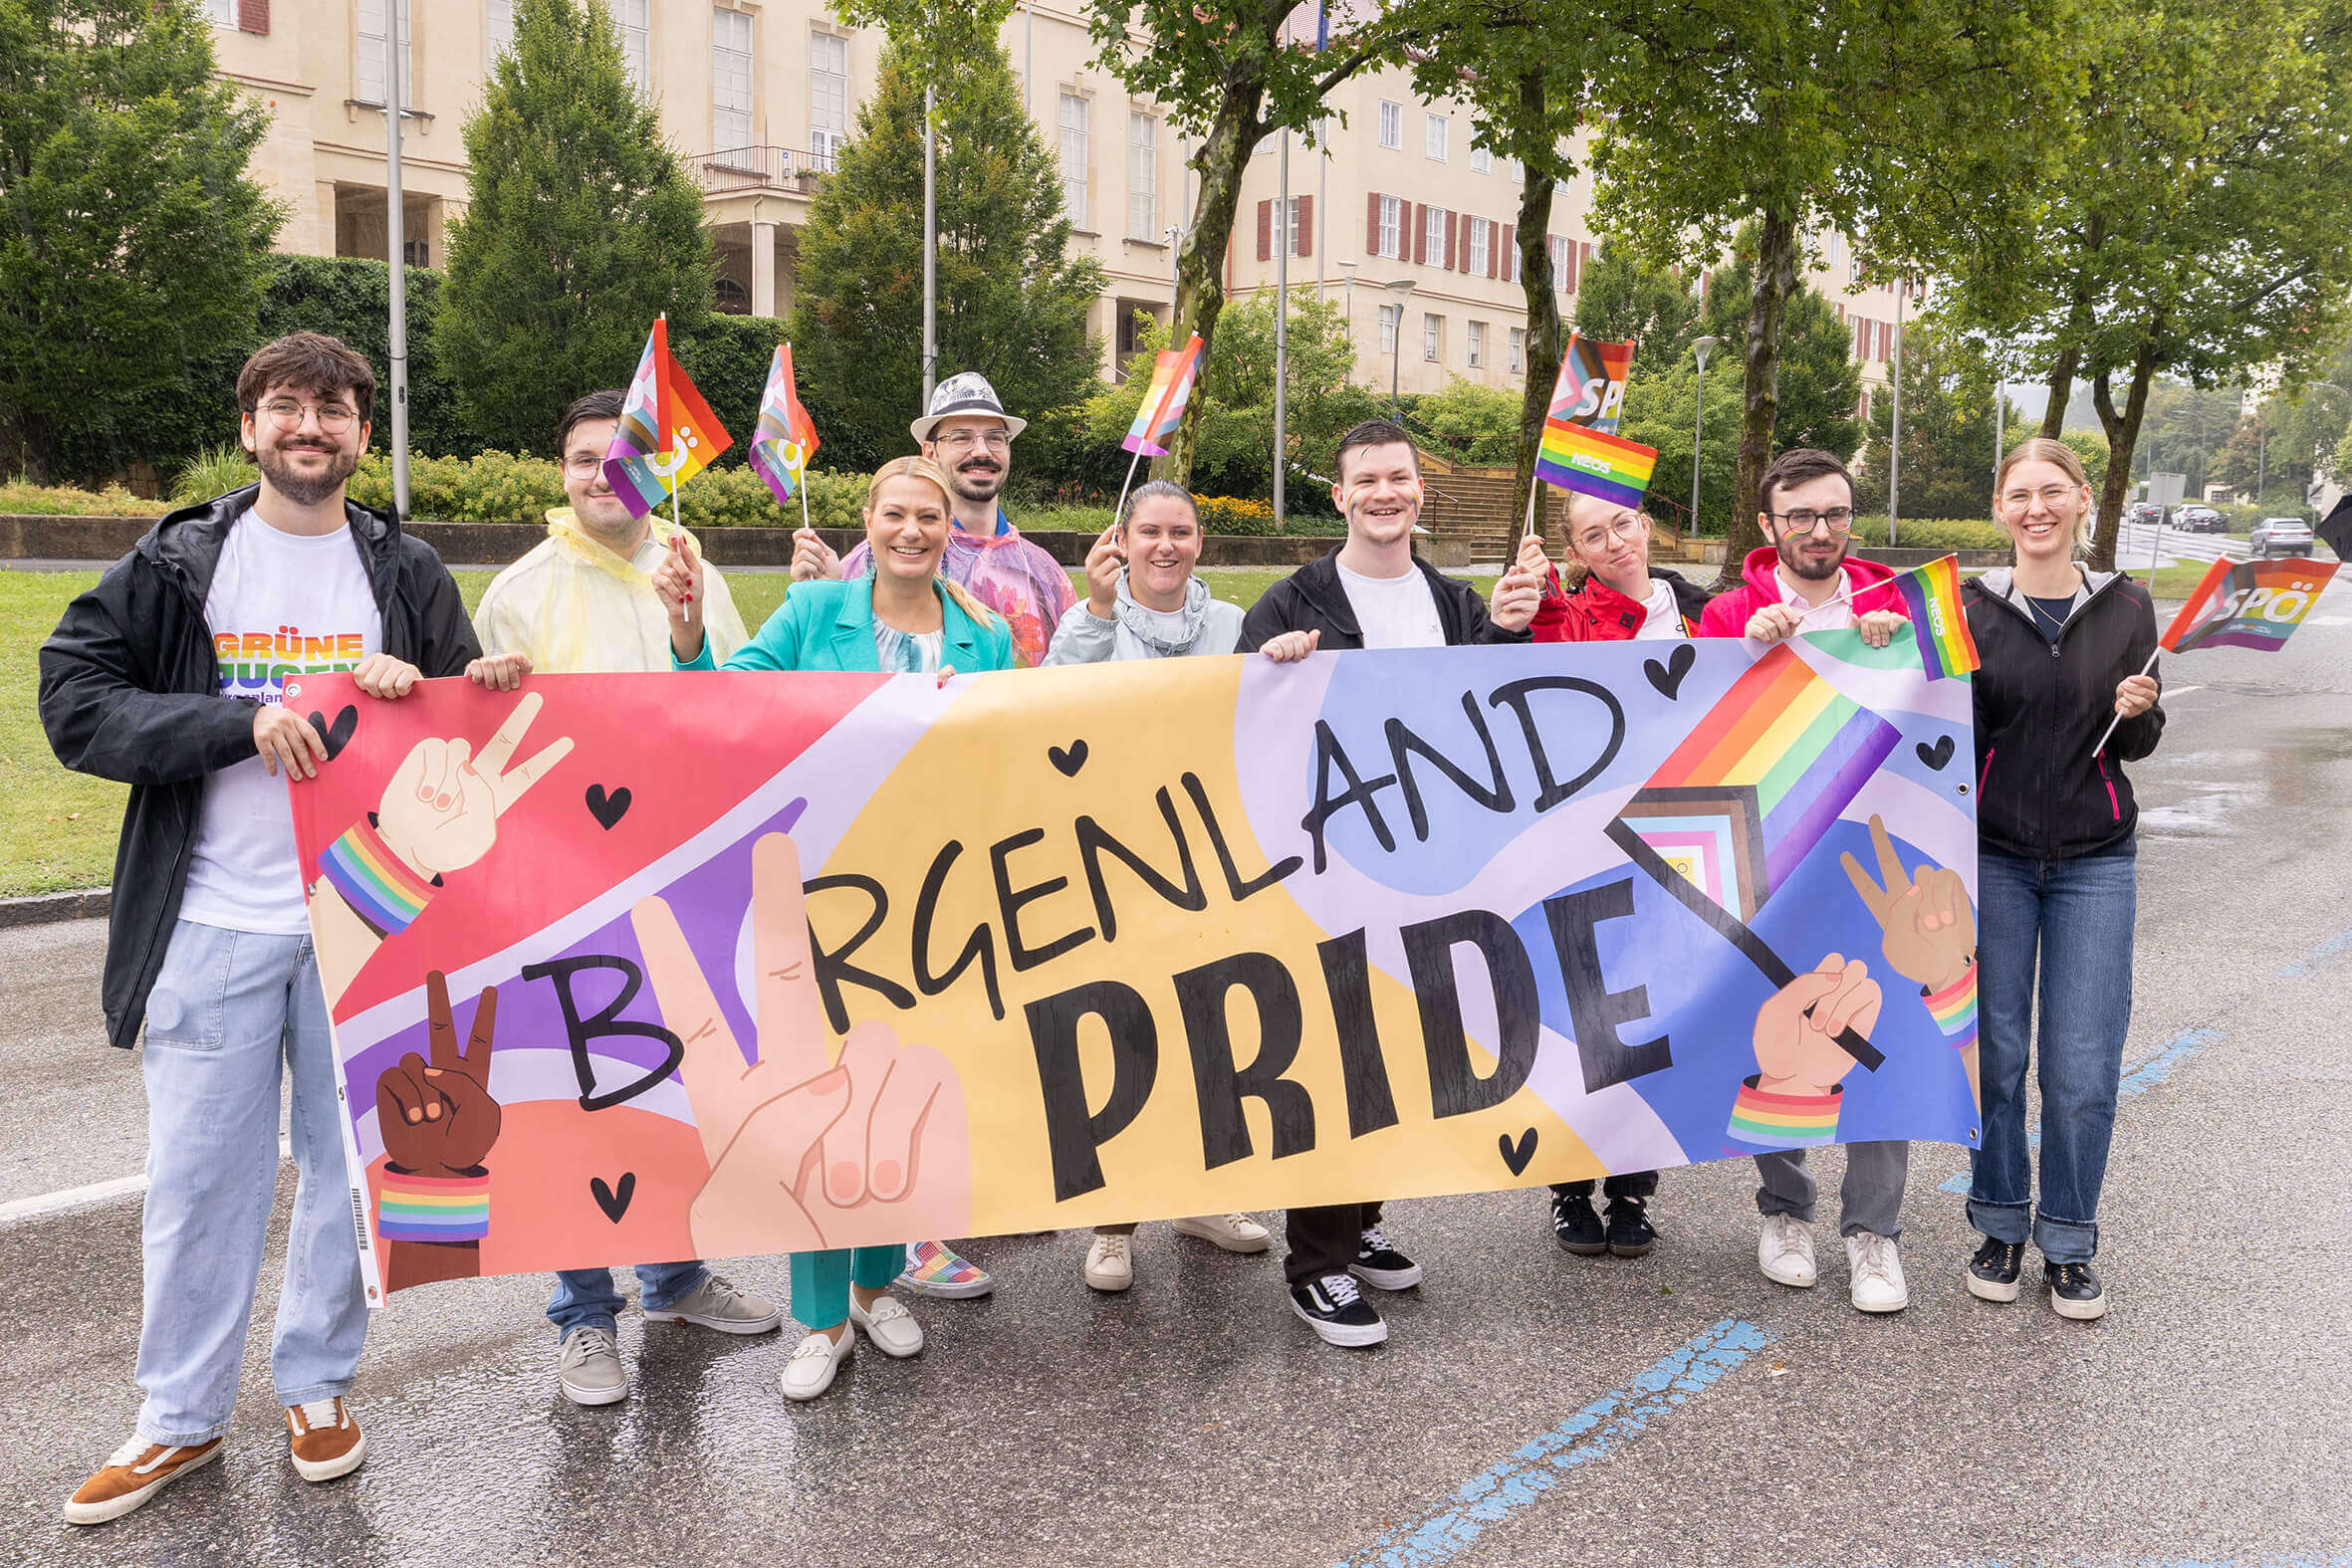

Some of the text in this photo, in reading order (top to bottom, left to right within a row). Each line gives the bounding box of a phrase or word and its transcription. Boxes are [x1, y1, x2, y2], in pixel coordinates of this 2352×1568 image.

[1572, 377, 1624, 419] SP
[1570, 451, 1611, 475] NEOS
[1929, 596, 1947, 637] NEOS
[2212, 580, 2314, 623] SPÖ
[213, 625, 363, 661] GRÜNE
[1024, 876, 1674, 1203] PRIDE
